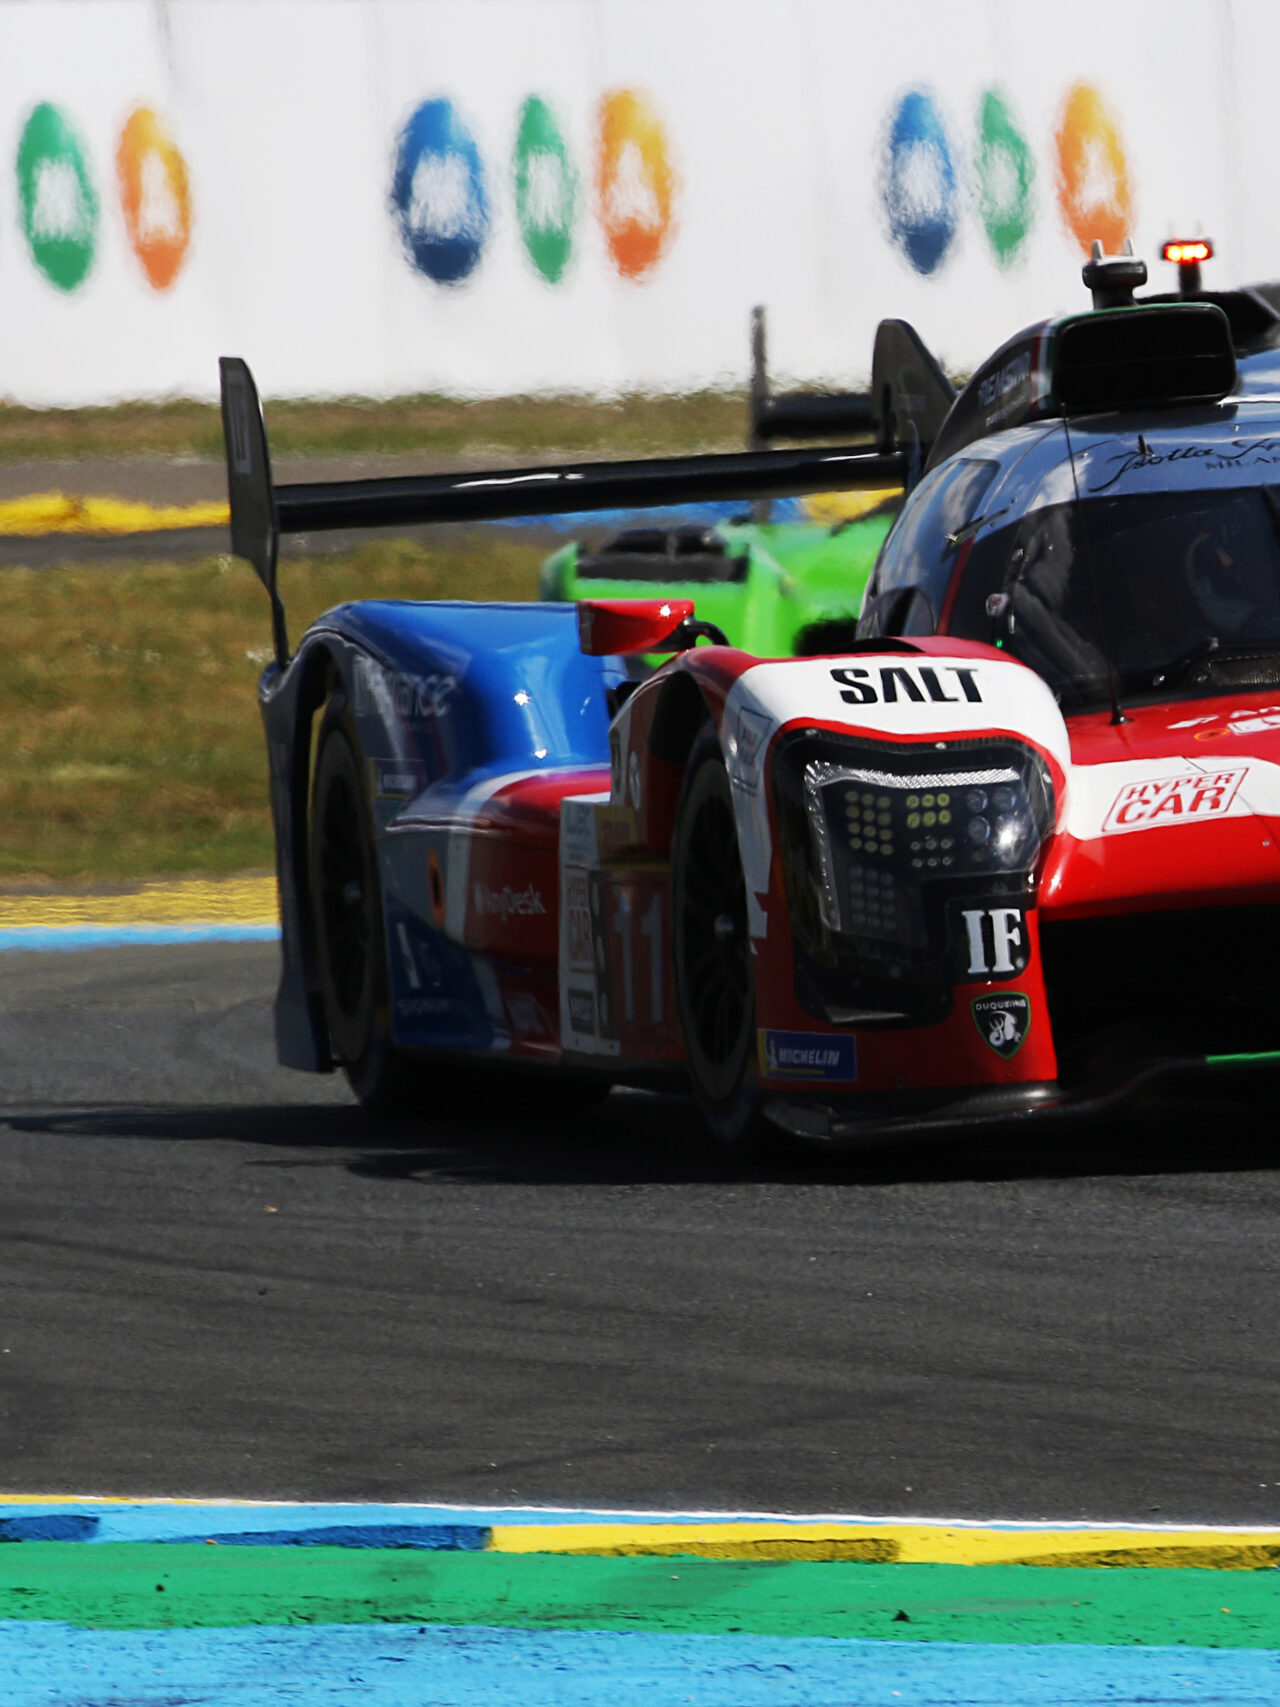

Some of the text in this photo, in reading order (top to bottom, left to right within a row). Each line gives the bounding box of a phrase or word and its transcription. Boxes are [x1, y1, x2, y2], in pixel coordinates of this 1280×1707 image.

[830, 667, 983, 704] SALT
[1126, 773, 1235, 799] HYPER
[1116, 787, 1226, 824] CAR
[612, 884, 663, 1023] 11
[961, 908, 1021, 974] IF
[778, 1048, 841, 1066] MICHELIN
